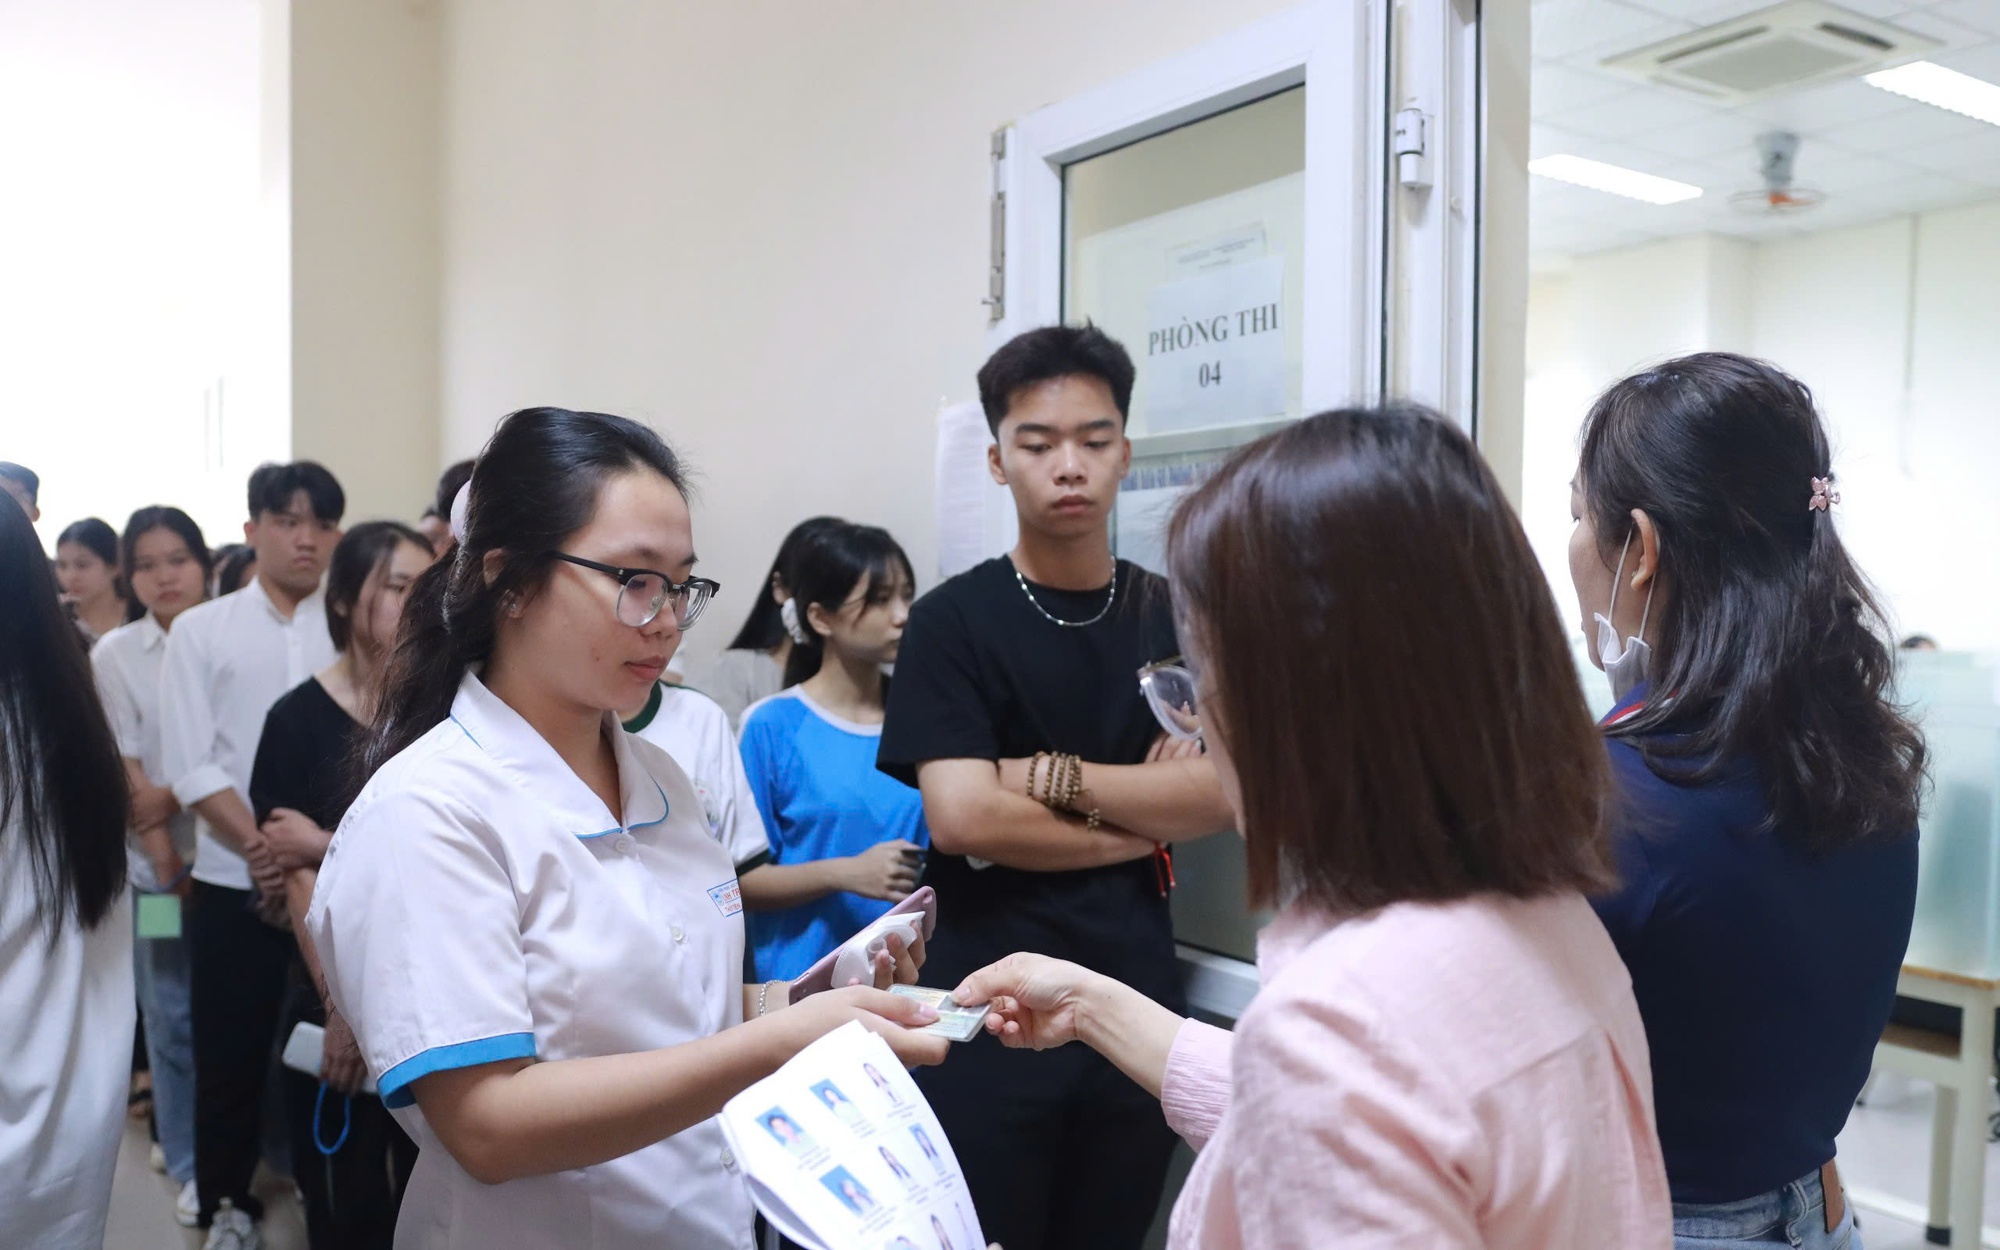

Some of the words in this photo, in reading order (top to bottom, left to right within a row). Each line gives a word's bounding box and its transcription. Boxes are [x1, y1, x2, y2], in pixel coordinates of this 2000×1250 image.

[1148, 315, 1228, 356] PHÒNG
[1234, 302, 1279, 337] THI
[1199, 360, 1222, 388] 04
